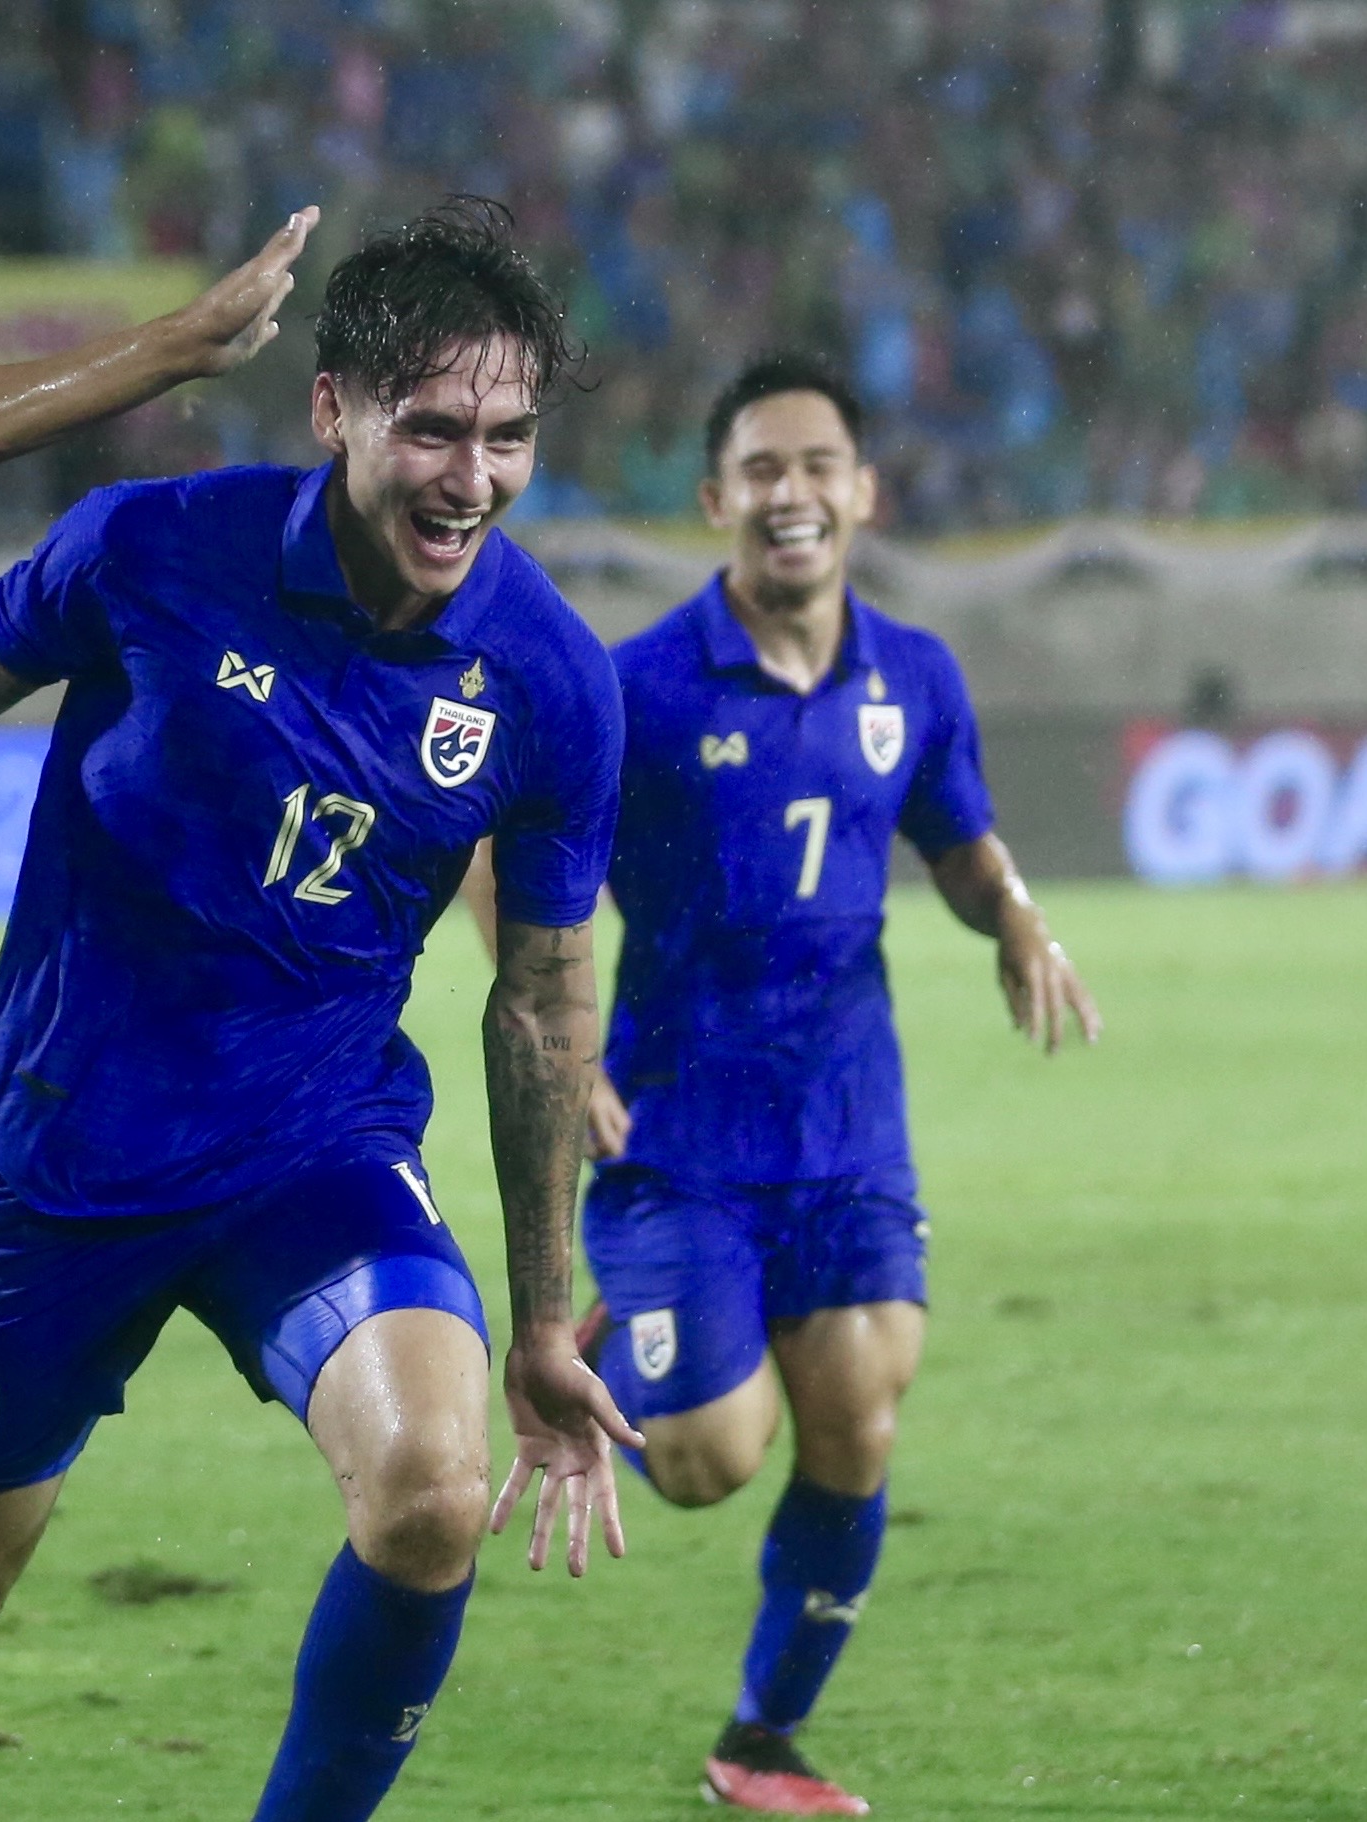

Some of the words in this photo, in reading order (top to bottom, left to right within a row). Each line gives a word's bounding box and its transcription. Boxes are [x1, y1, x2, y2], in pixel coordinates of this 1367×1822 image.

[439, 706, 486, 726] THAILAND
[262, 783, 376, 905] 12
[785, 797, 832, 898] 7
